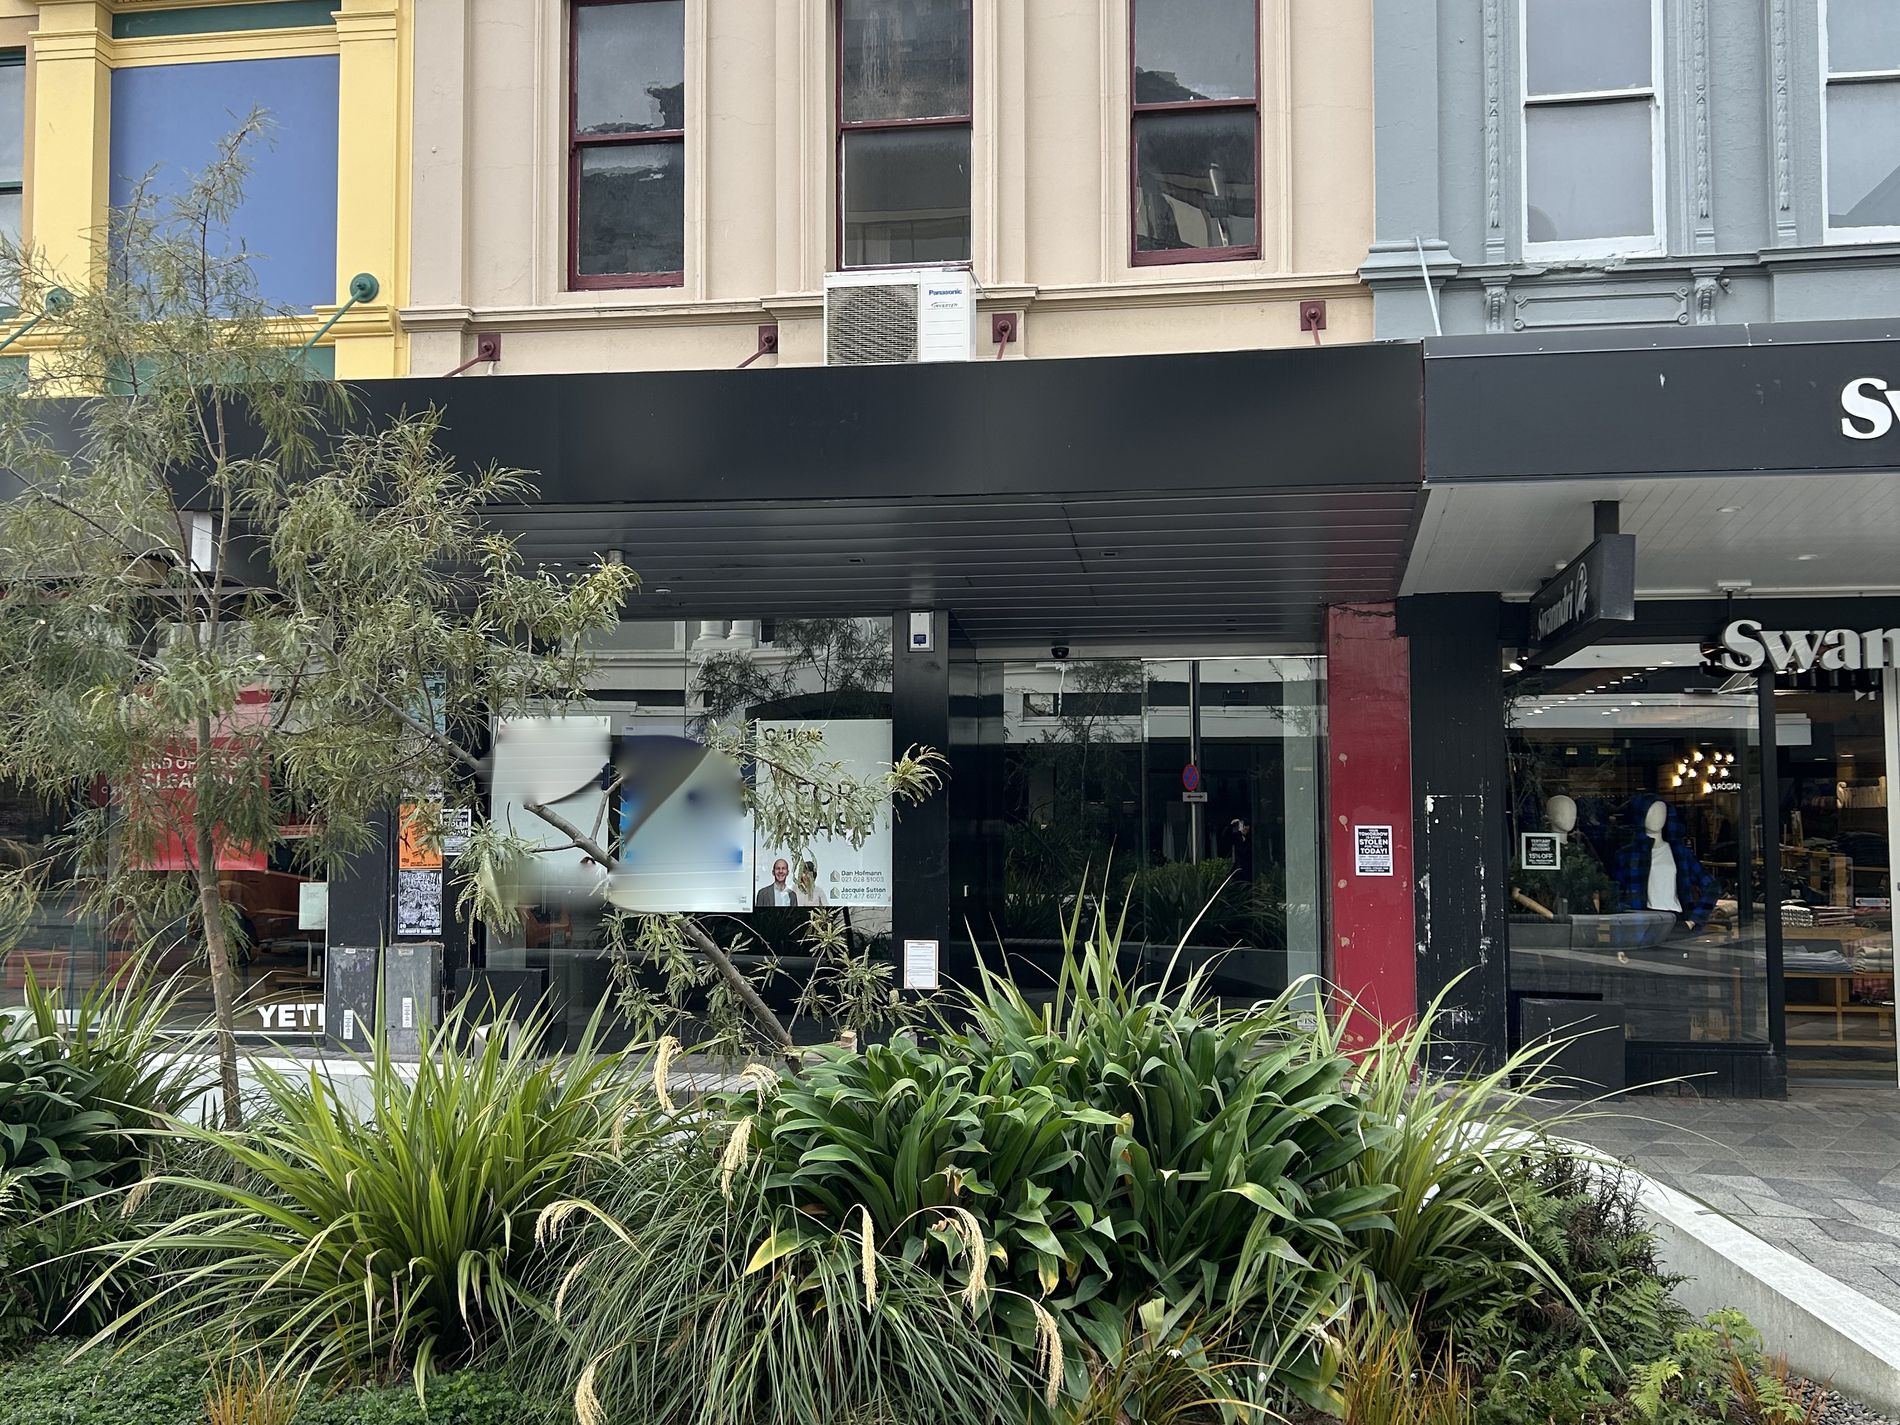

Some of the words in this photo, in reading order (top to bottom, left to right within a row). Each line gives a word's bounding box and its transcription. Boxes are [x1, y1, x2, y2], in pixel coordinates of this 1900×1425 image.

[928, 288, 963, 296] Panasonic
[1721, 619, 1900, 671] Swan
[256, 1004, 326, 1028] YETI
